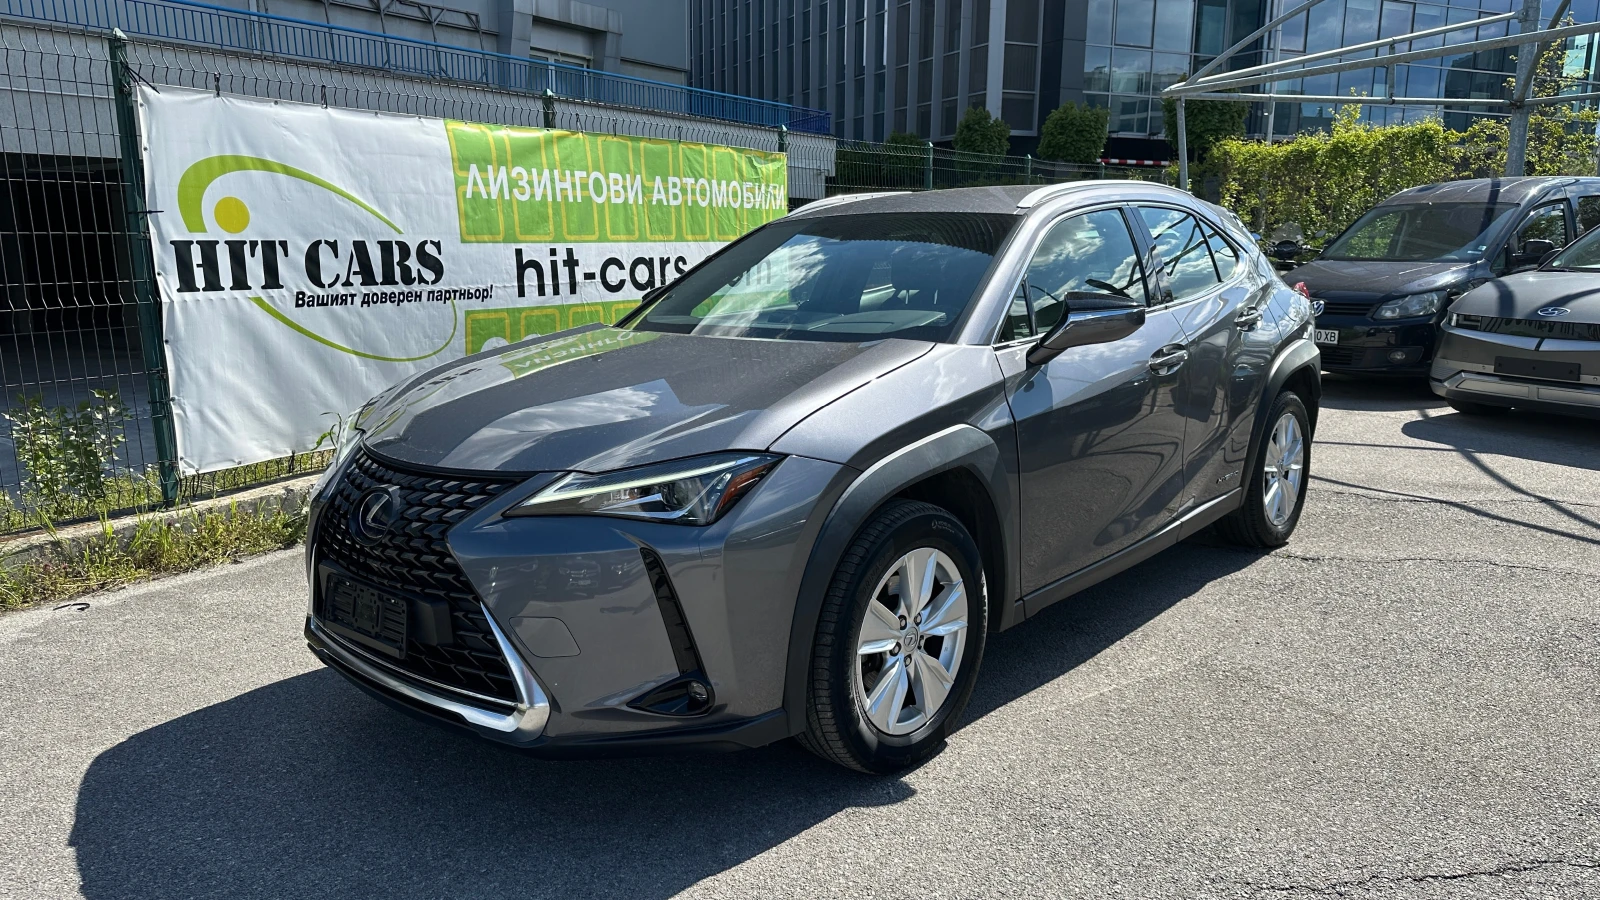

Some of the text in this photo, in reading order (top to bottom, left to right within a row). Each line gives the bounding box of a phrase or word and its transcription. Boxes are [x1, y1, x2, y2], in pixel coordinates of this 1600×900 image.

[465, 163, 786, 210] ЛИЗИНГОВИ АВТОМОБИЛИ
[169, 238, 445, 293] HIT CARS
[294, 284, 494, 308] Вашият доверен партньор!
